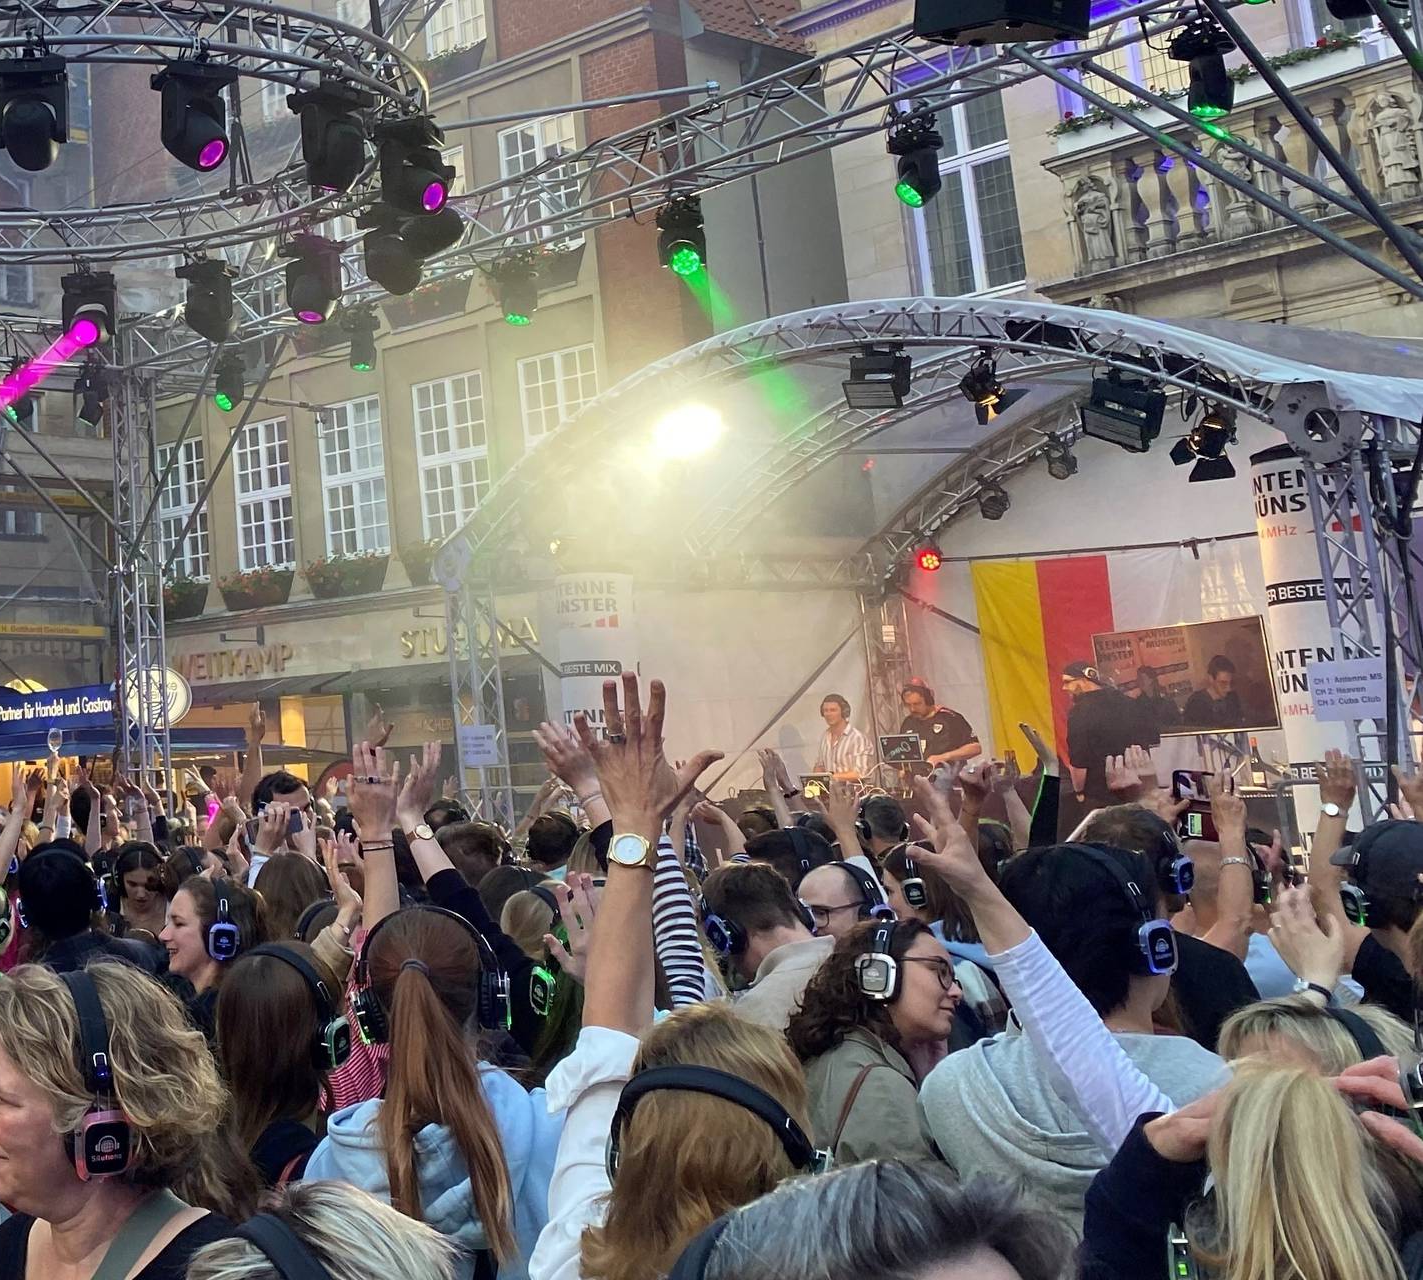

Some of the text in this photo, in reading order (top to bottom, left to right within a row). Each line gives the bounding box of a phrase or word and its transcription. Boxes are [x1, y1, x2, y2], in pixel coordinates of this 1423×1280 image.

[1253, 469, 1337, 495] NTEN
[558, 581, 616, 597] TENNE
[401, 617, 541, 659] STUMA
[24, 702, 34, 719] für
[35, 698, 64, 717] Handel
[65, 697, 80, 716] und
